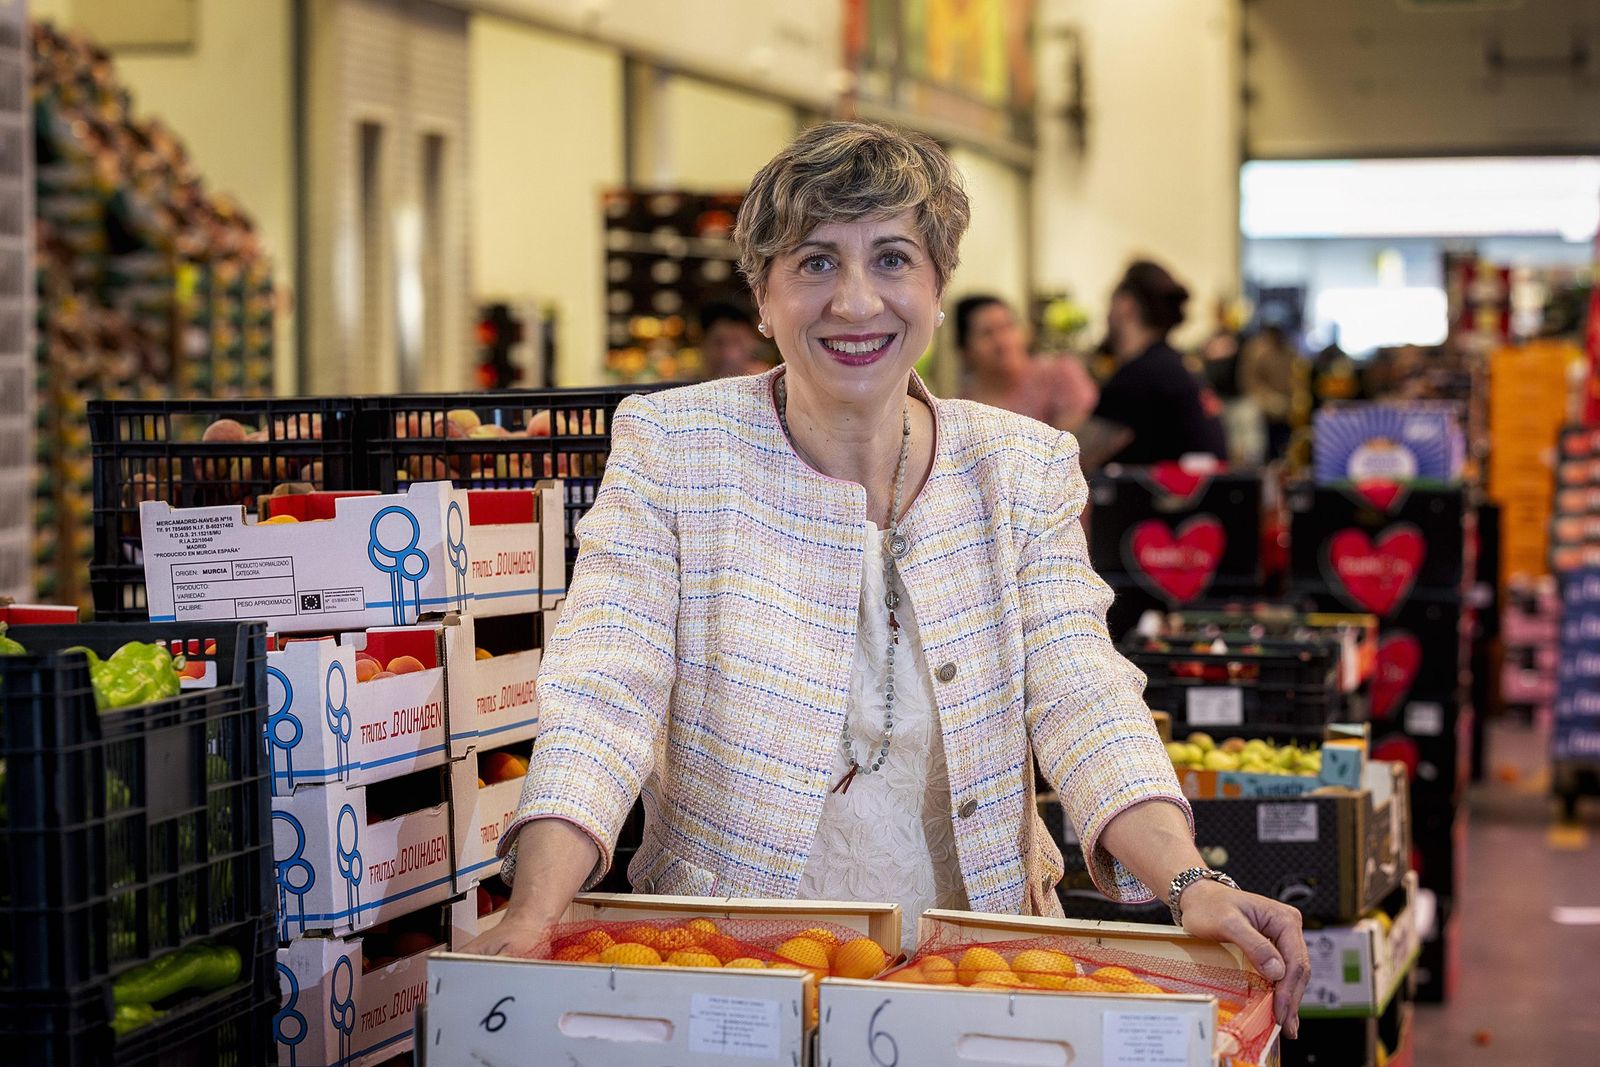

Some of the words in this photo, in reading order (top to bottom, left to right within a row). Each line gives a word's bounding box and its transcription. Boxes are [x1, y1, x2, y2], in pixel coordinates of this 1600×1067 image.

[472, 560, 493, 579] FRUTAS
[495, 550, 536, 576] BOUHABEN
[360, 721, 387, 745] FRUTAS
[391, 701, 442, 738] BOUHABEN
[476, 695, 497, 715] FRUTAS
[369, 859, 396, 886] FRUTAS
[399, 834, 448, 875] BOUHABEN
[361, 1004, 387, 1033] FRUTAS
[479, 996, 515, 1033] 6
[867, 999, 898, 1067] 6
